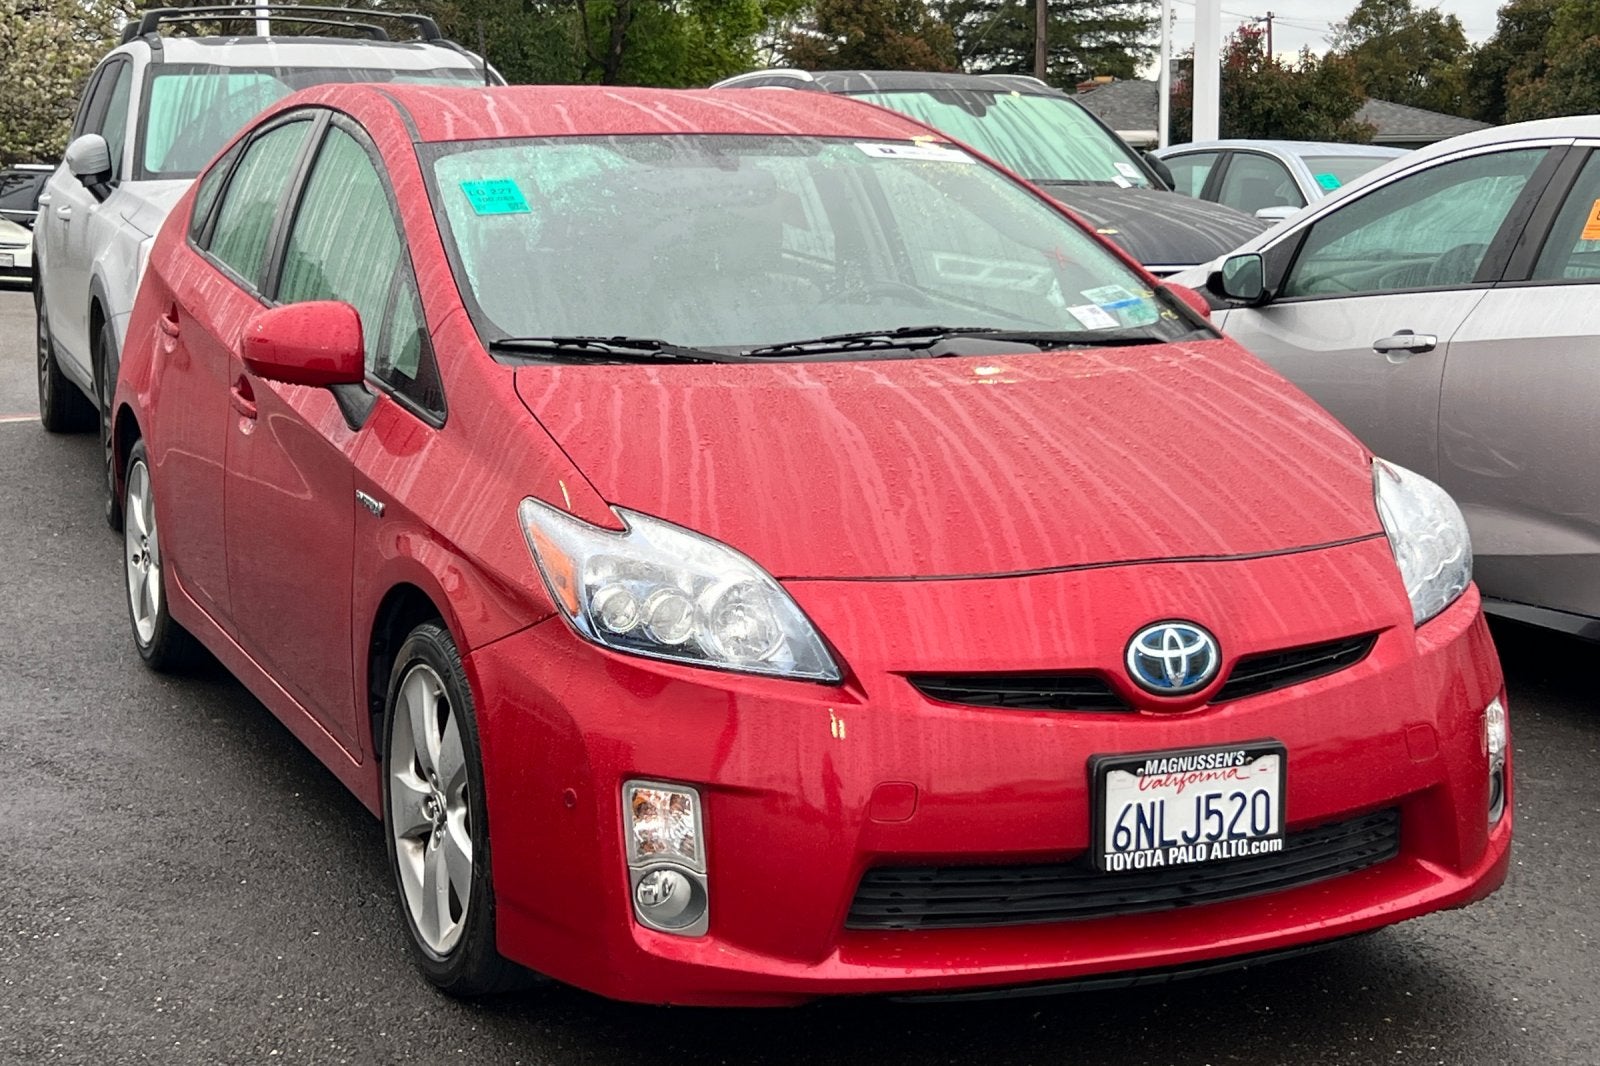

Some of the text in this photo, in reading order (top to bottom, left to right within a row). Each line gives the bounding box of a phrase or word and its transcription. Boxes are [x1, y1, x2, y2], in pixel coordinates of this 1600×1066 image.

[1145, 750, 1246, 775] MAGNUSSEN'S
[1138, 768, 1250, 794] California
[1112, 788, 1271, 851] 6NLJ520
[1104, 838, 1283, 872] TOYOTA PALO ALTO.com
